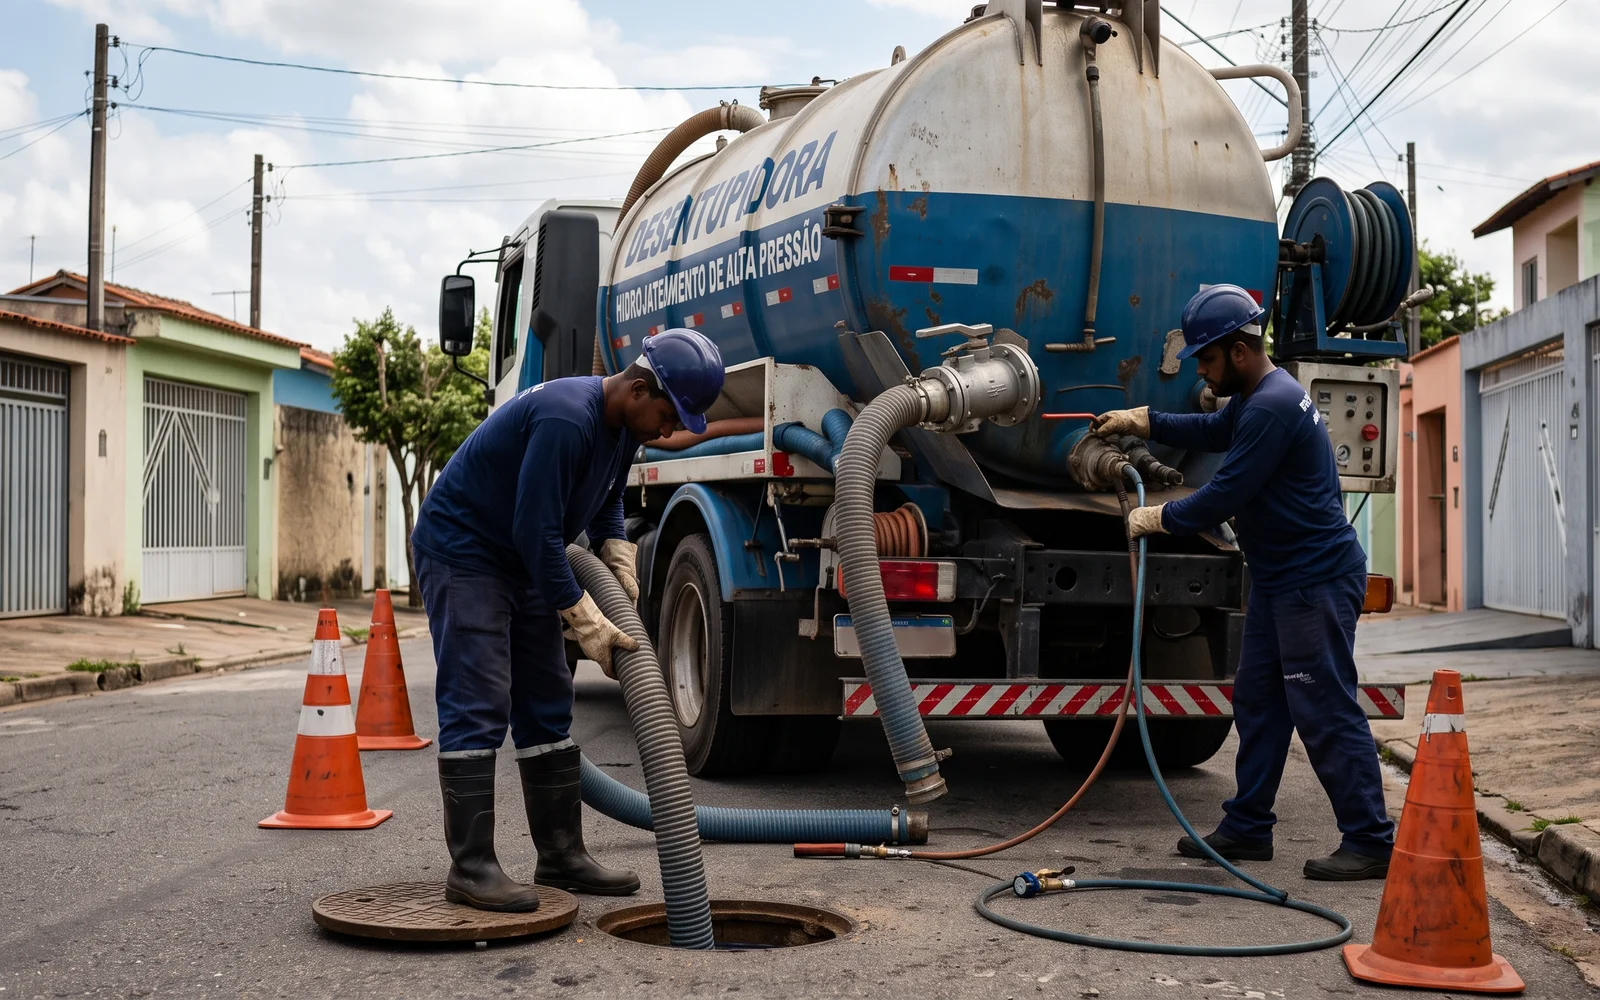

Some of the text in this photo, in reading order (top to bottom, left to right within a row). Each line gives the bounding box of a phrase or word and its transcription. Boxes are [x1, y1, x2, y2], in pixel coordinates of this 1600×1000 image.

[624, 130, 838, 268] DESENTUPIDORA
[709, 257, 725, 294] DE
[726, 246, 757, 288] ALTA
[759, 218, 822, 276] PRESSÃO
